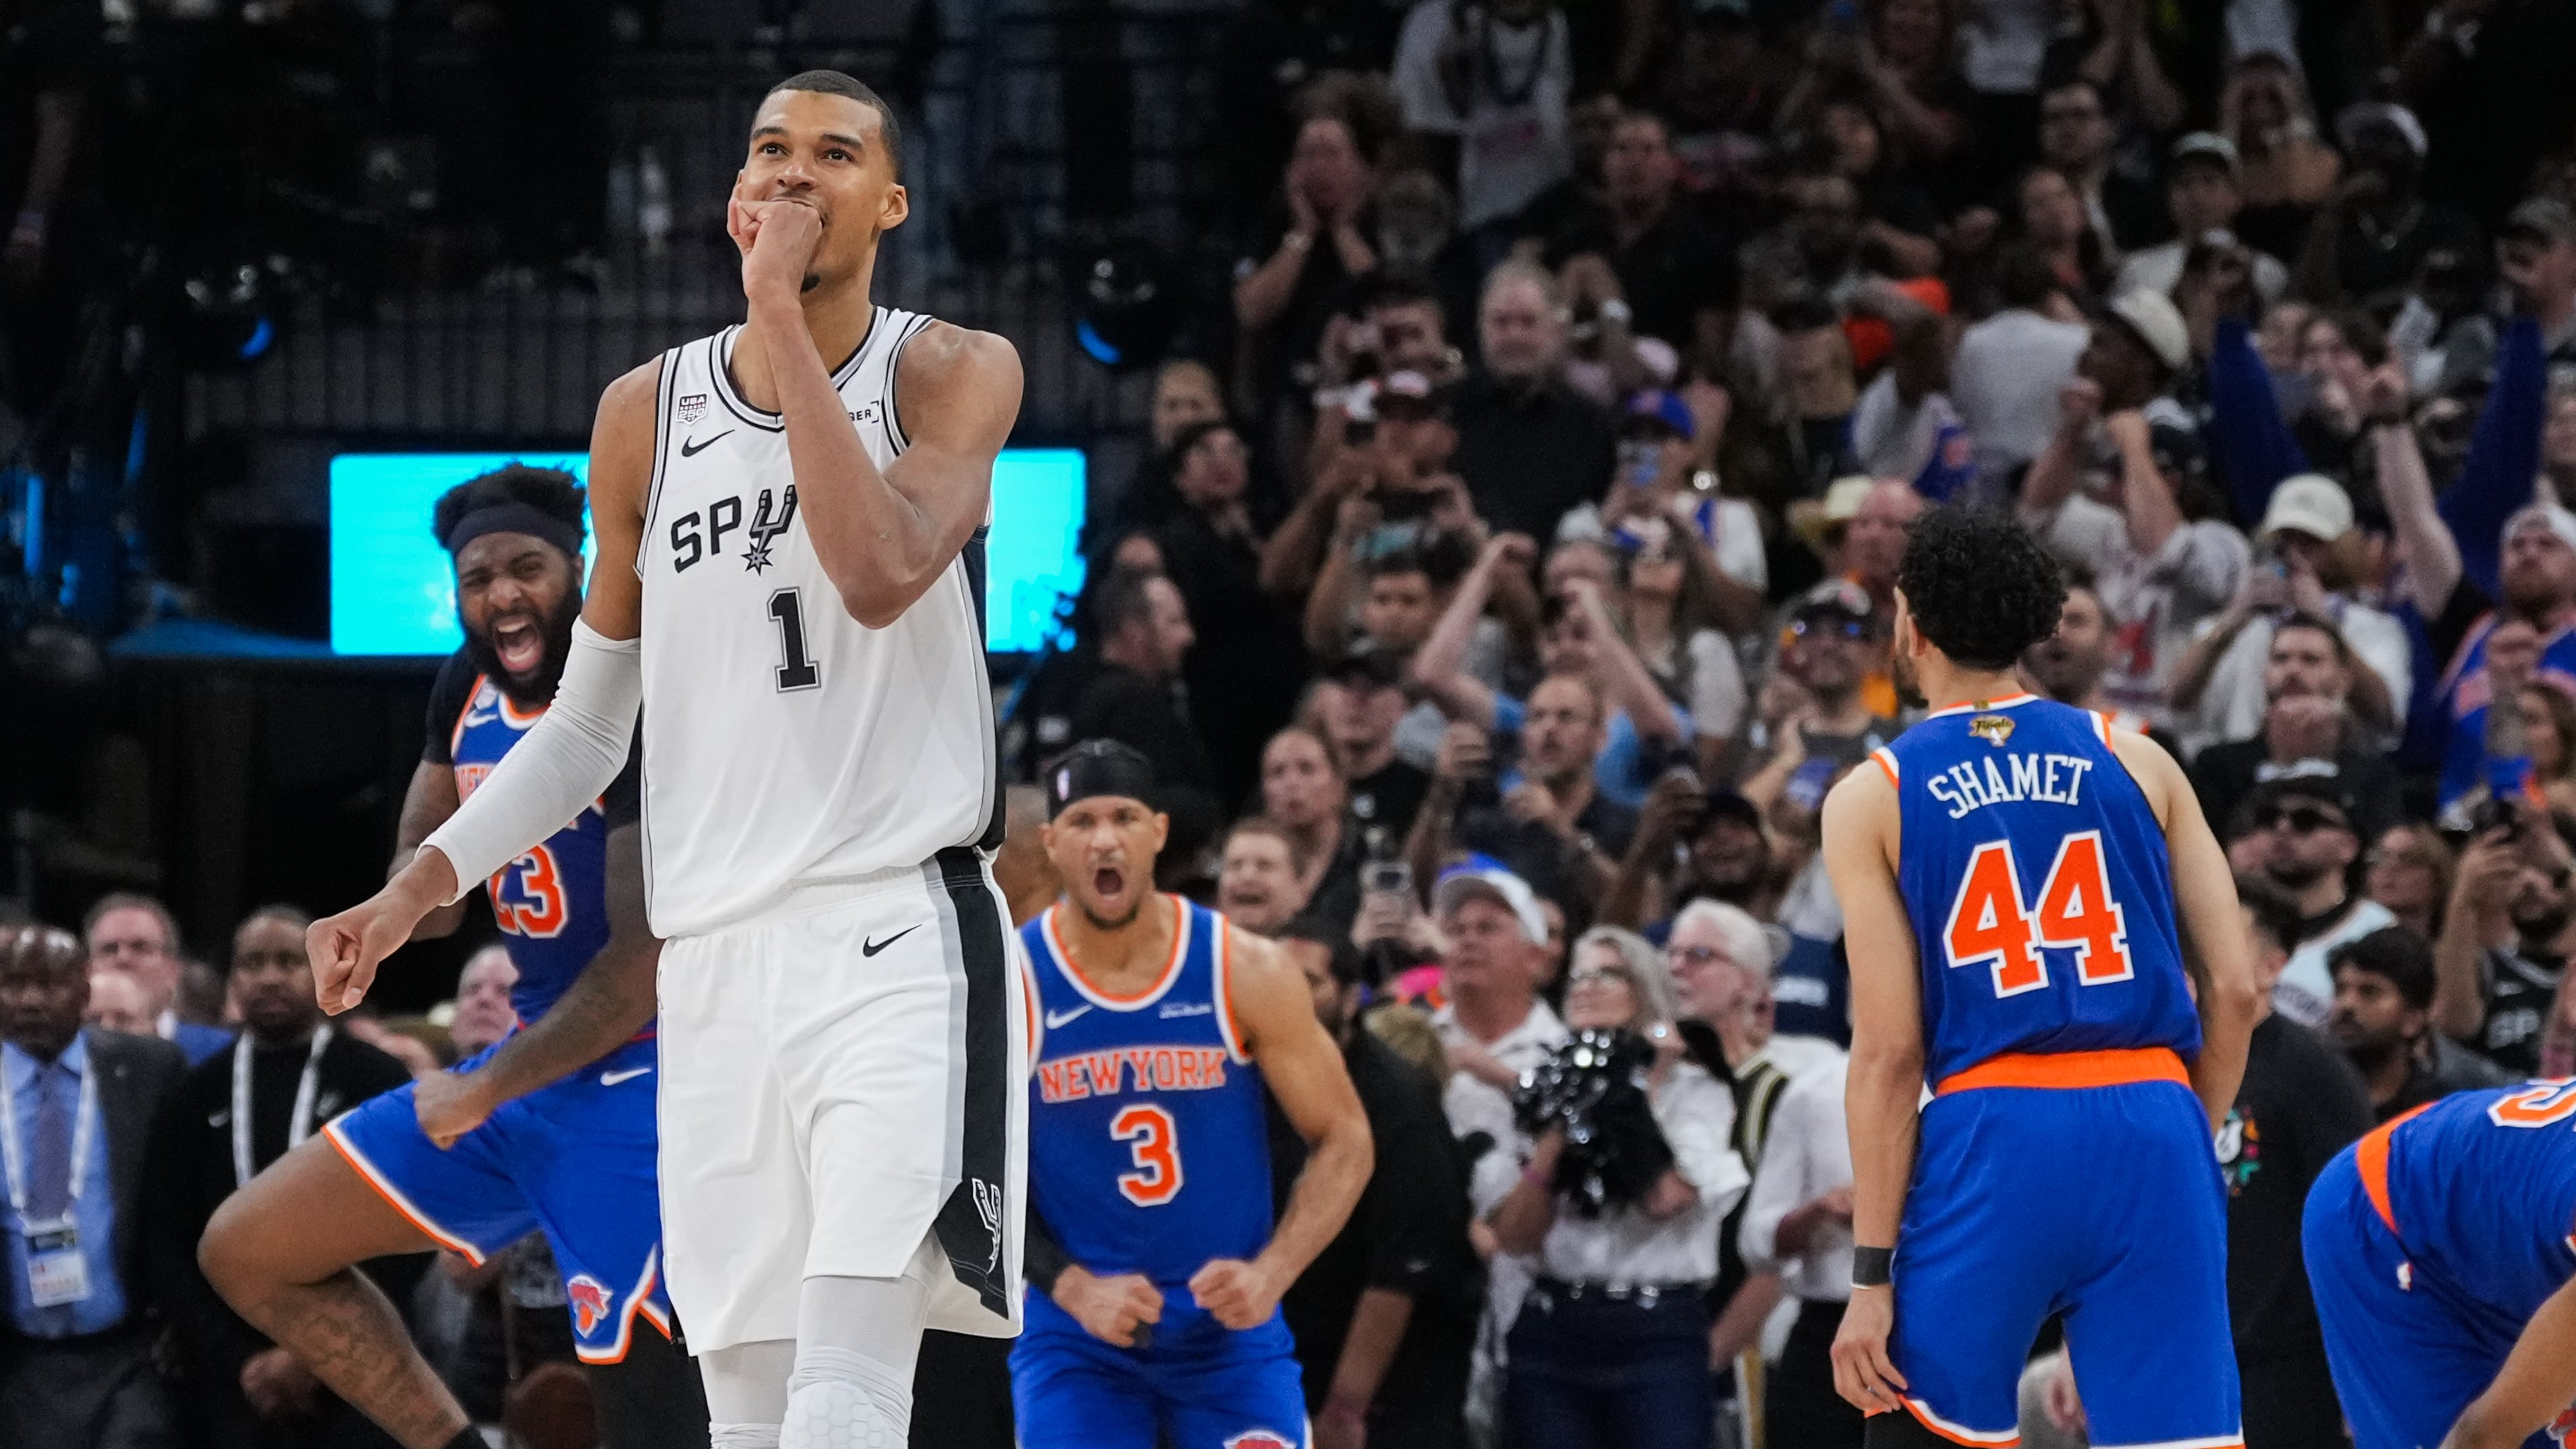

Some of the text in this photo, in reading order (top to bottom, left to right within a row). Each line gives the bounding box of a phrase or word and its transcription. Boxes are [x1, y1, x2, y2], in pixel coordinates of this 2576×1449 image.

[678, 408, 704, 419] 250
[767, 586, 821, 694] 1
[454, 763, 496, 805] NE
[1927, 753, 2092, 819] SHAMET
[1943, 830, 2134, 998] 44
[1039, 1046, 1226, 1103] NEW YORK
[1110, 1102, 1184, 1208] 3
